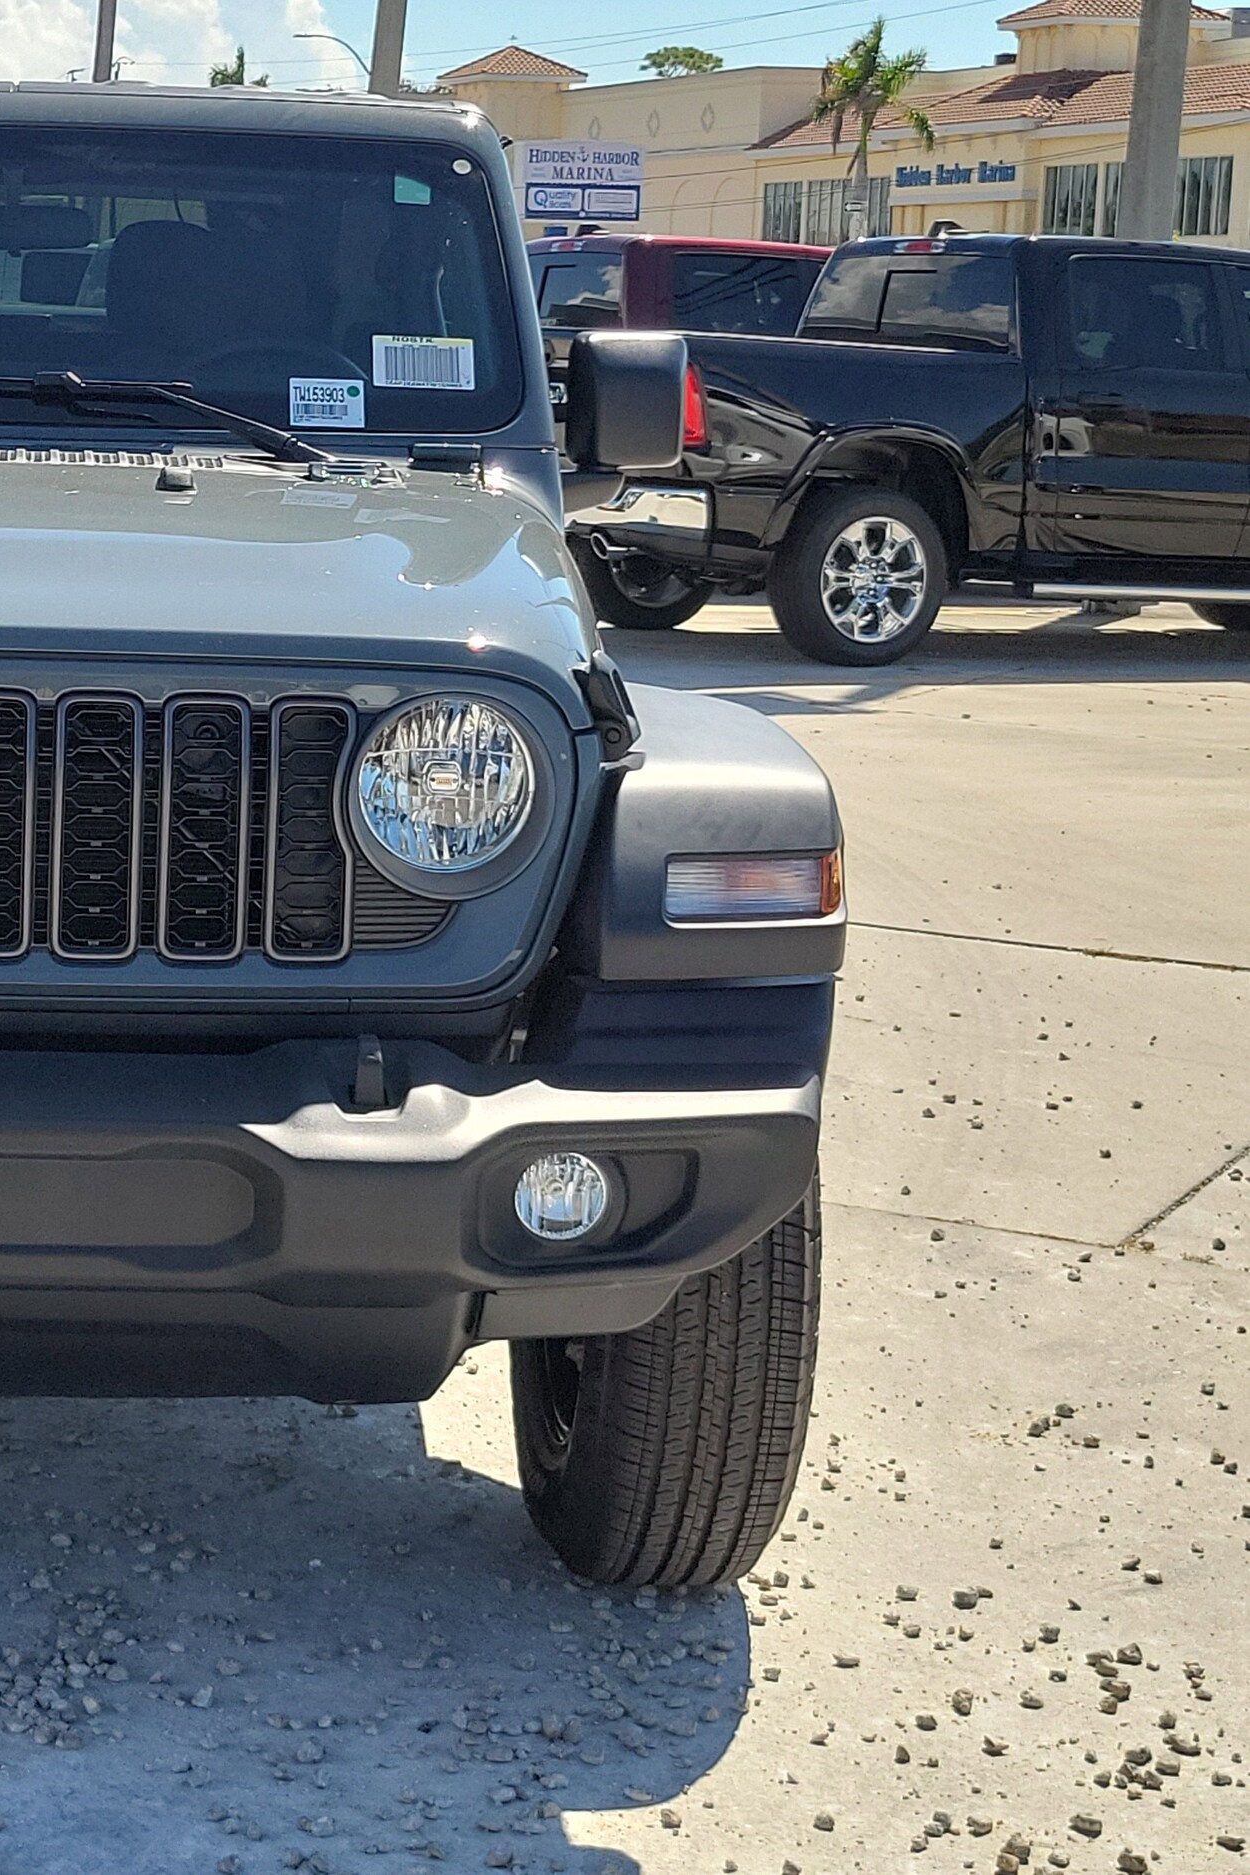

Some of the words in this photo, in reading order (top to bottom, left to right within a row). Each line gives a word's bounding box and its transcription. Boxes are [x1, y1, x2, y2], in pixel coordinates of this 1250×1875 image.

[529, 148, 575, 163] HIDDEN
[592, 151, 639, 166] HARBOR
[551, 166, 614, 180] MARINA
[293, 386, 345, 403] TW153903
